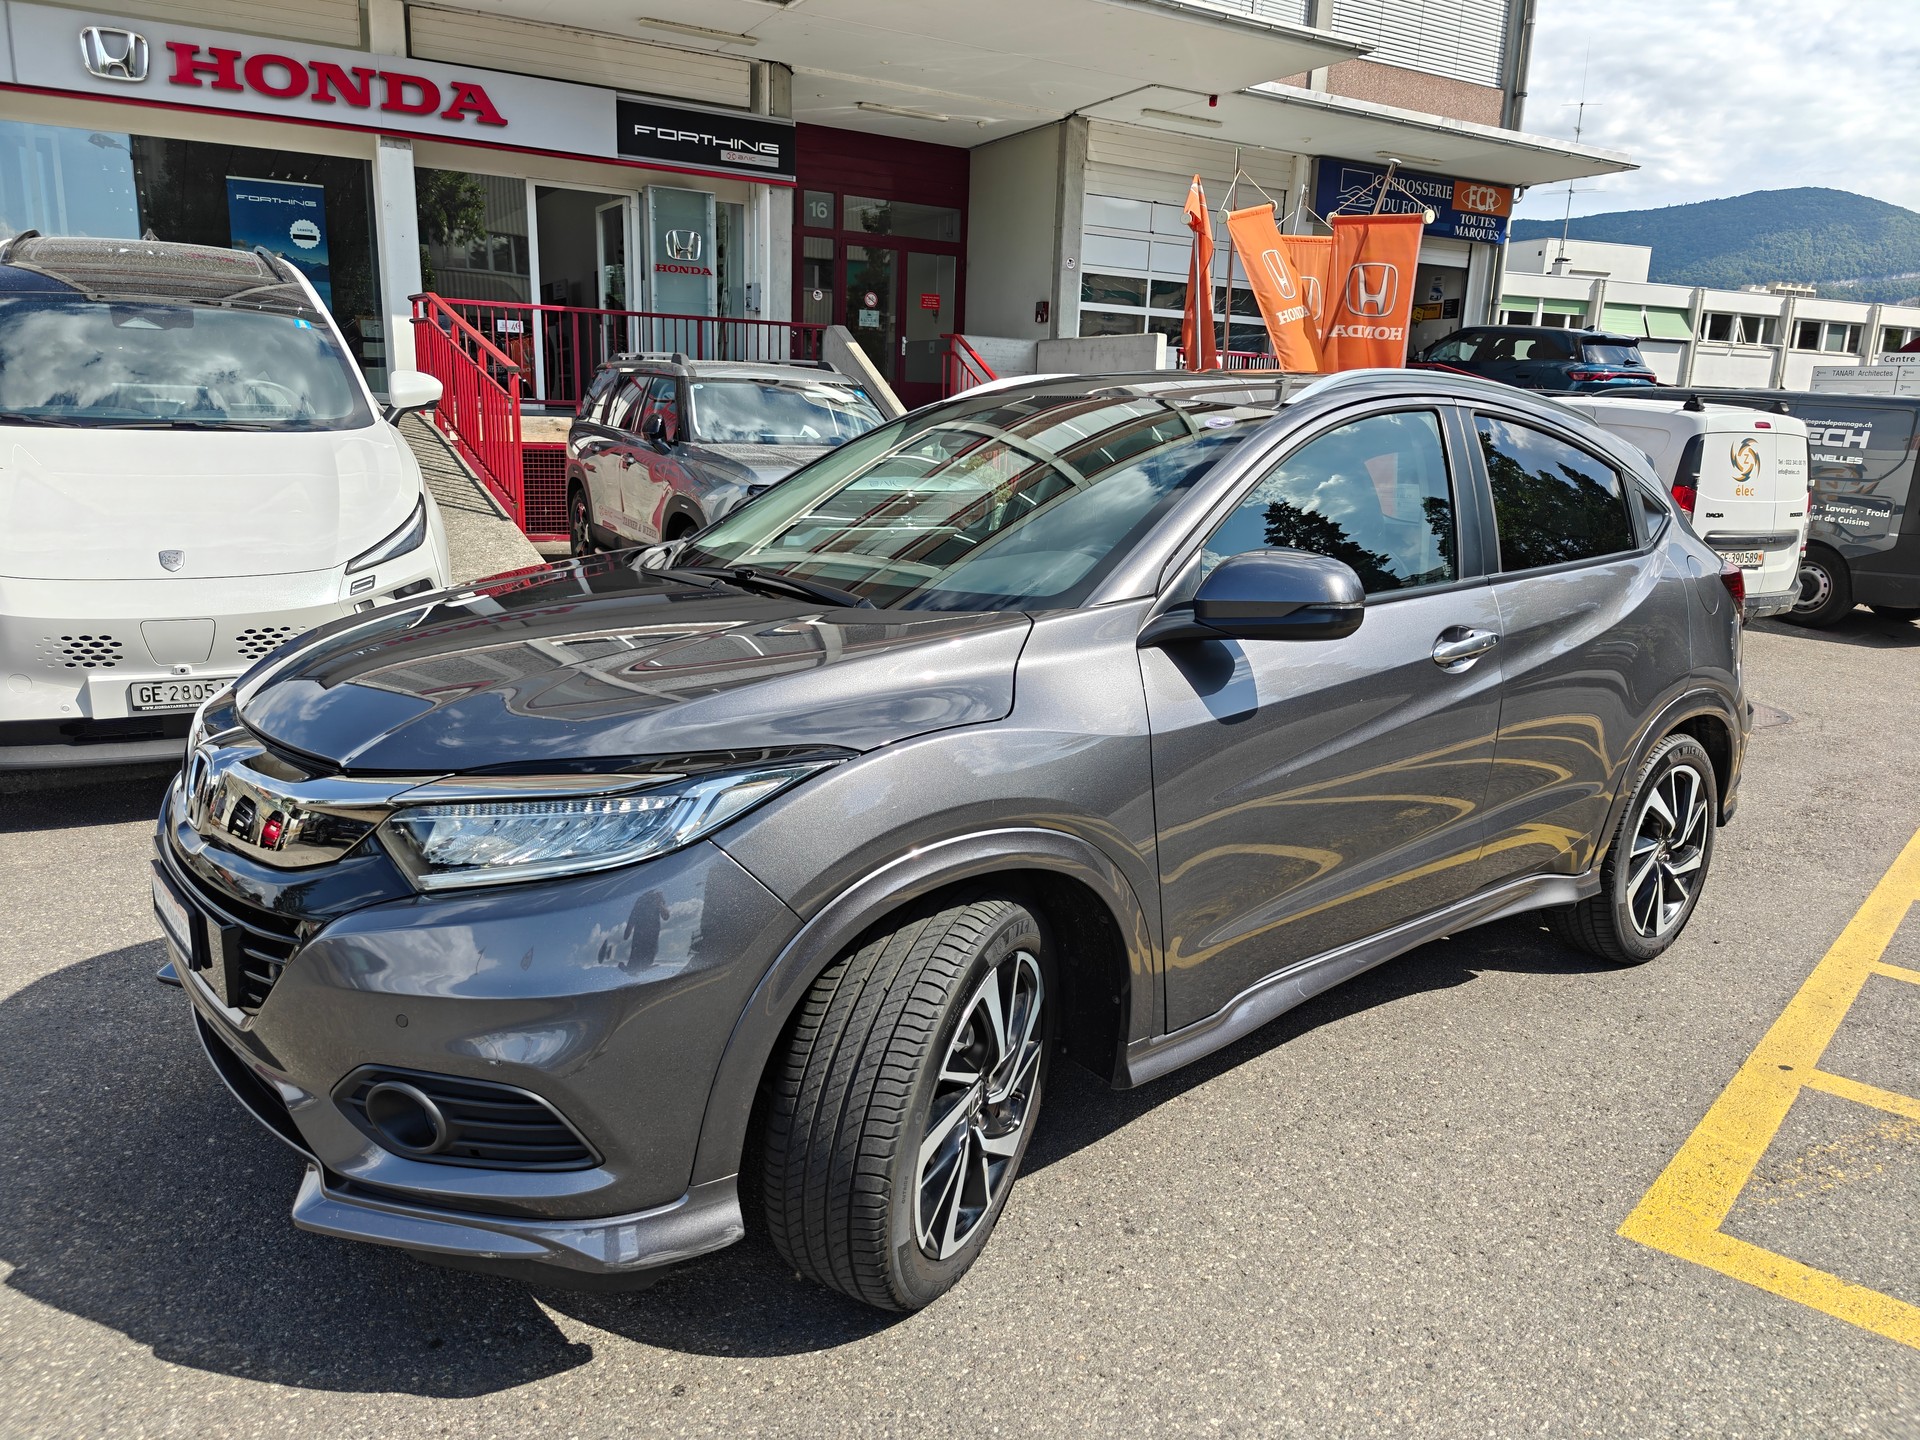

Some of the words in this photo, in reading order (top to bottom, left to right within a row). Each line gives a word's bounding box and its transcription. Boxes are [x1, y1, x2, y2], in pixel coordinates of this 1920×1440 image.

[165, 41, 508, 126] HONDA
[634, 124, 779, 154] FORTHING
[236, 194, 316, 207] FORTHING
[1382, 198, 1400, 213] DU
[1468, 185, 1496, 212] FCR
[809, 201, 828, 218] 16
[1460, 214, 1496, 228] TOUTES
[1454, 225, 1500, 240] MARQUES
[655, 264, 712, 276] HONDA
[1276, 305, 1310, 326] HONDA
[1884, 355, 1916, 363] Centre
[1736, 484, 1754, 496] élec
[1826, 504, 1858, 514] Laverie
[1866, 508, 1890, 518] Froid
[1824, 514, 1836, 522] de
[1838, 516, 1870, 526] Cuisine
